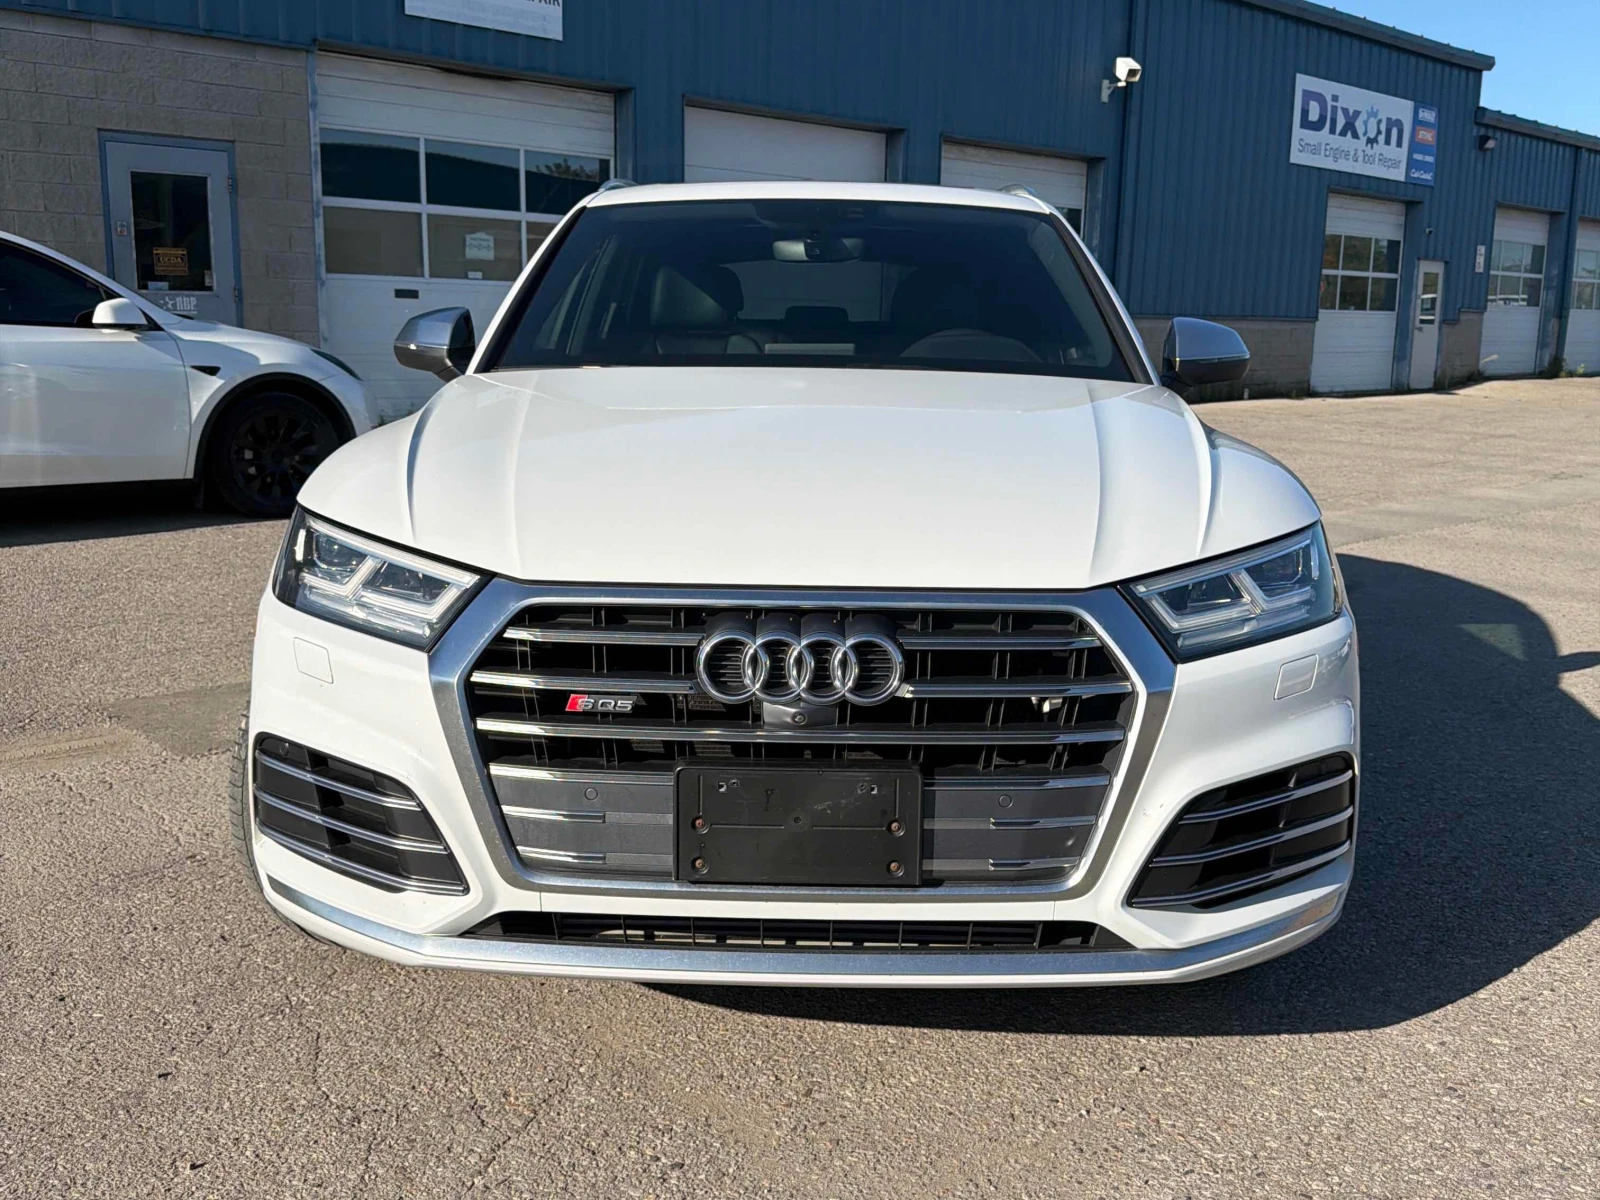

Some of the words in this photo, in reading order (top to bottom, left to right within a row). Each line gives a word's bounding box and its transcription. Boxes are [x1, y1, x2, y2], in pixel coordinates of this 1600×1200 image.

[1299, 89, 1405, 149] Dixon
[1297, 138, 1322, 155] Small
[1324, 143, 1351, 163] Engine
[1352, 148, 1359, 163] &
[1361, 150, 1376, 165] Tool
[1378, 153, 1402, 170] Repair
[575, 697, 635, 712] SQ5
